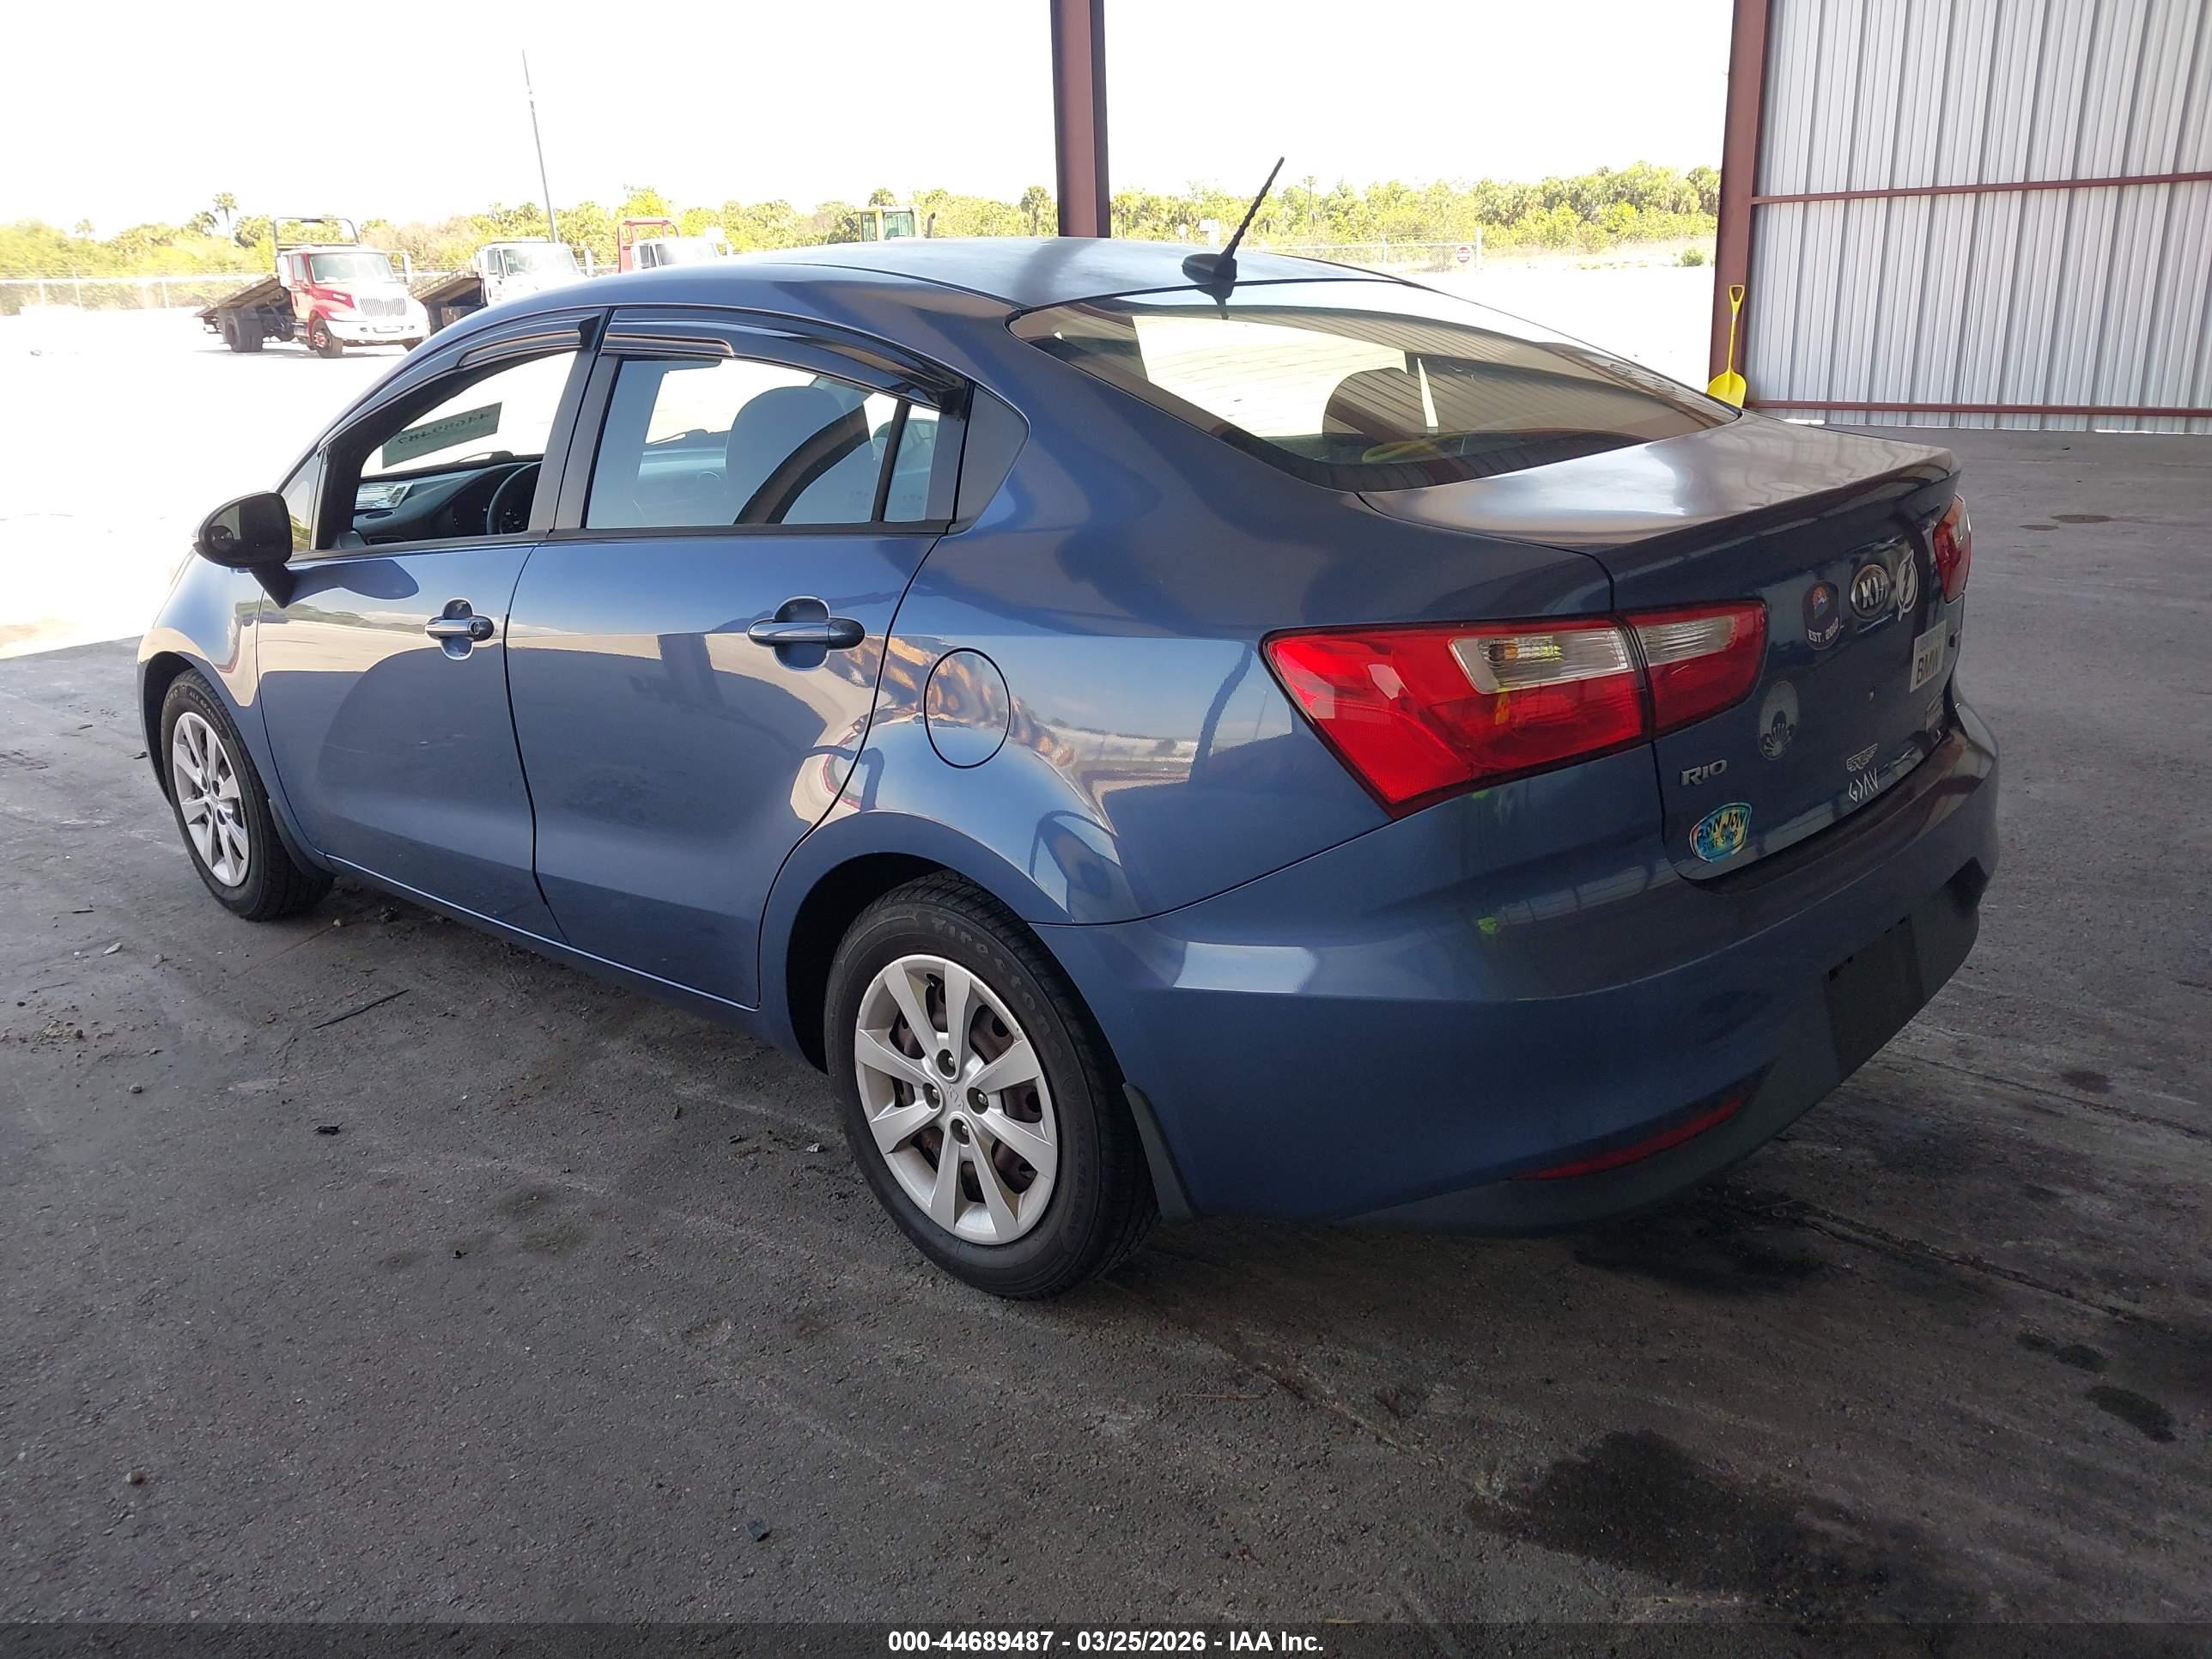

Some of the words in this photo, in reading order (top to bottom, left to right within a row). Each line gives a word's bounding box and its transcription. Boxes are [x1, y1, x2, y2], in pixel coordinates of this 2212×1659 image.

[1808, 629, 1824, 643] EST.
[1681, 759, 1728, 786] RIO
[1697, 815, 1722, 842] RON
[1727, 811, 1746, 830] JON
